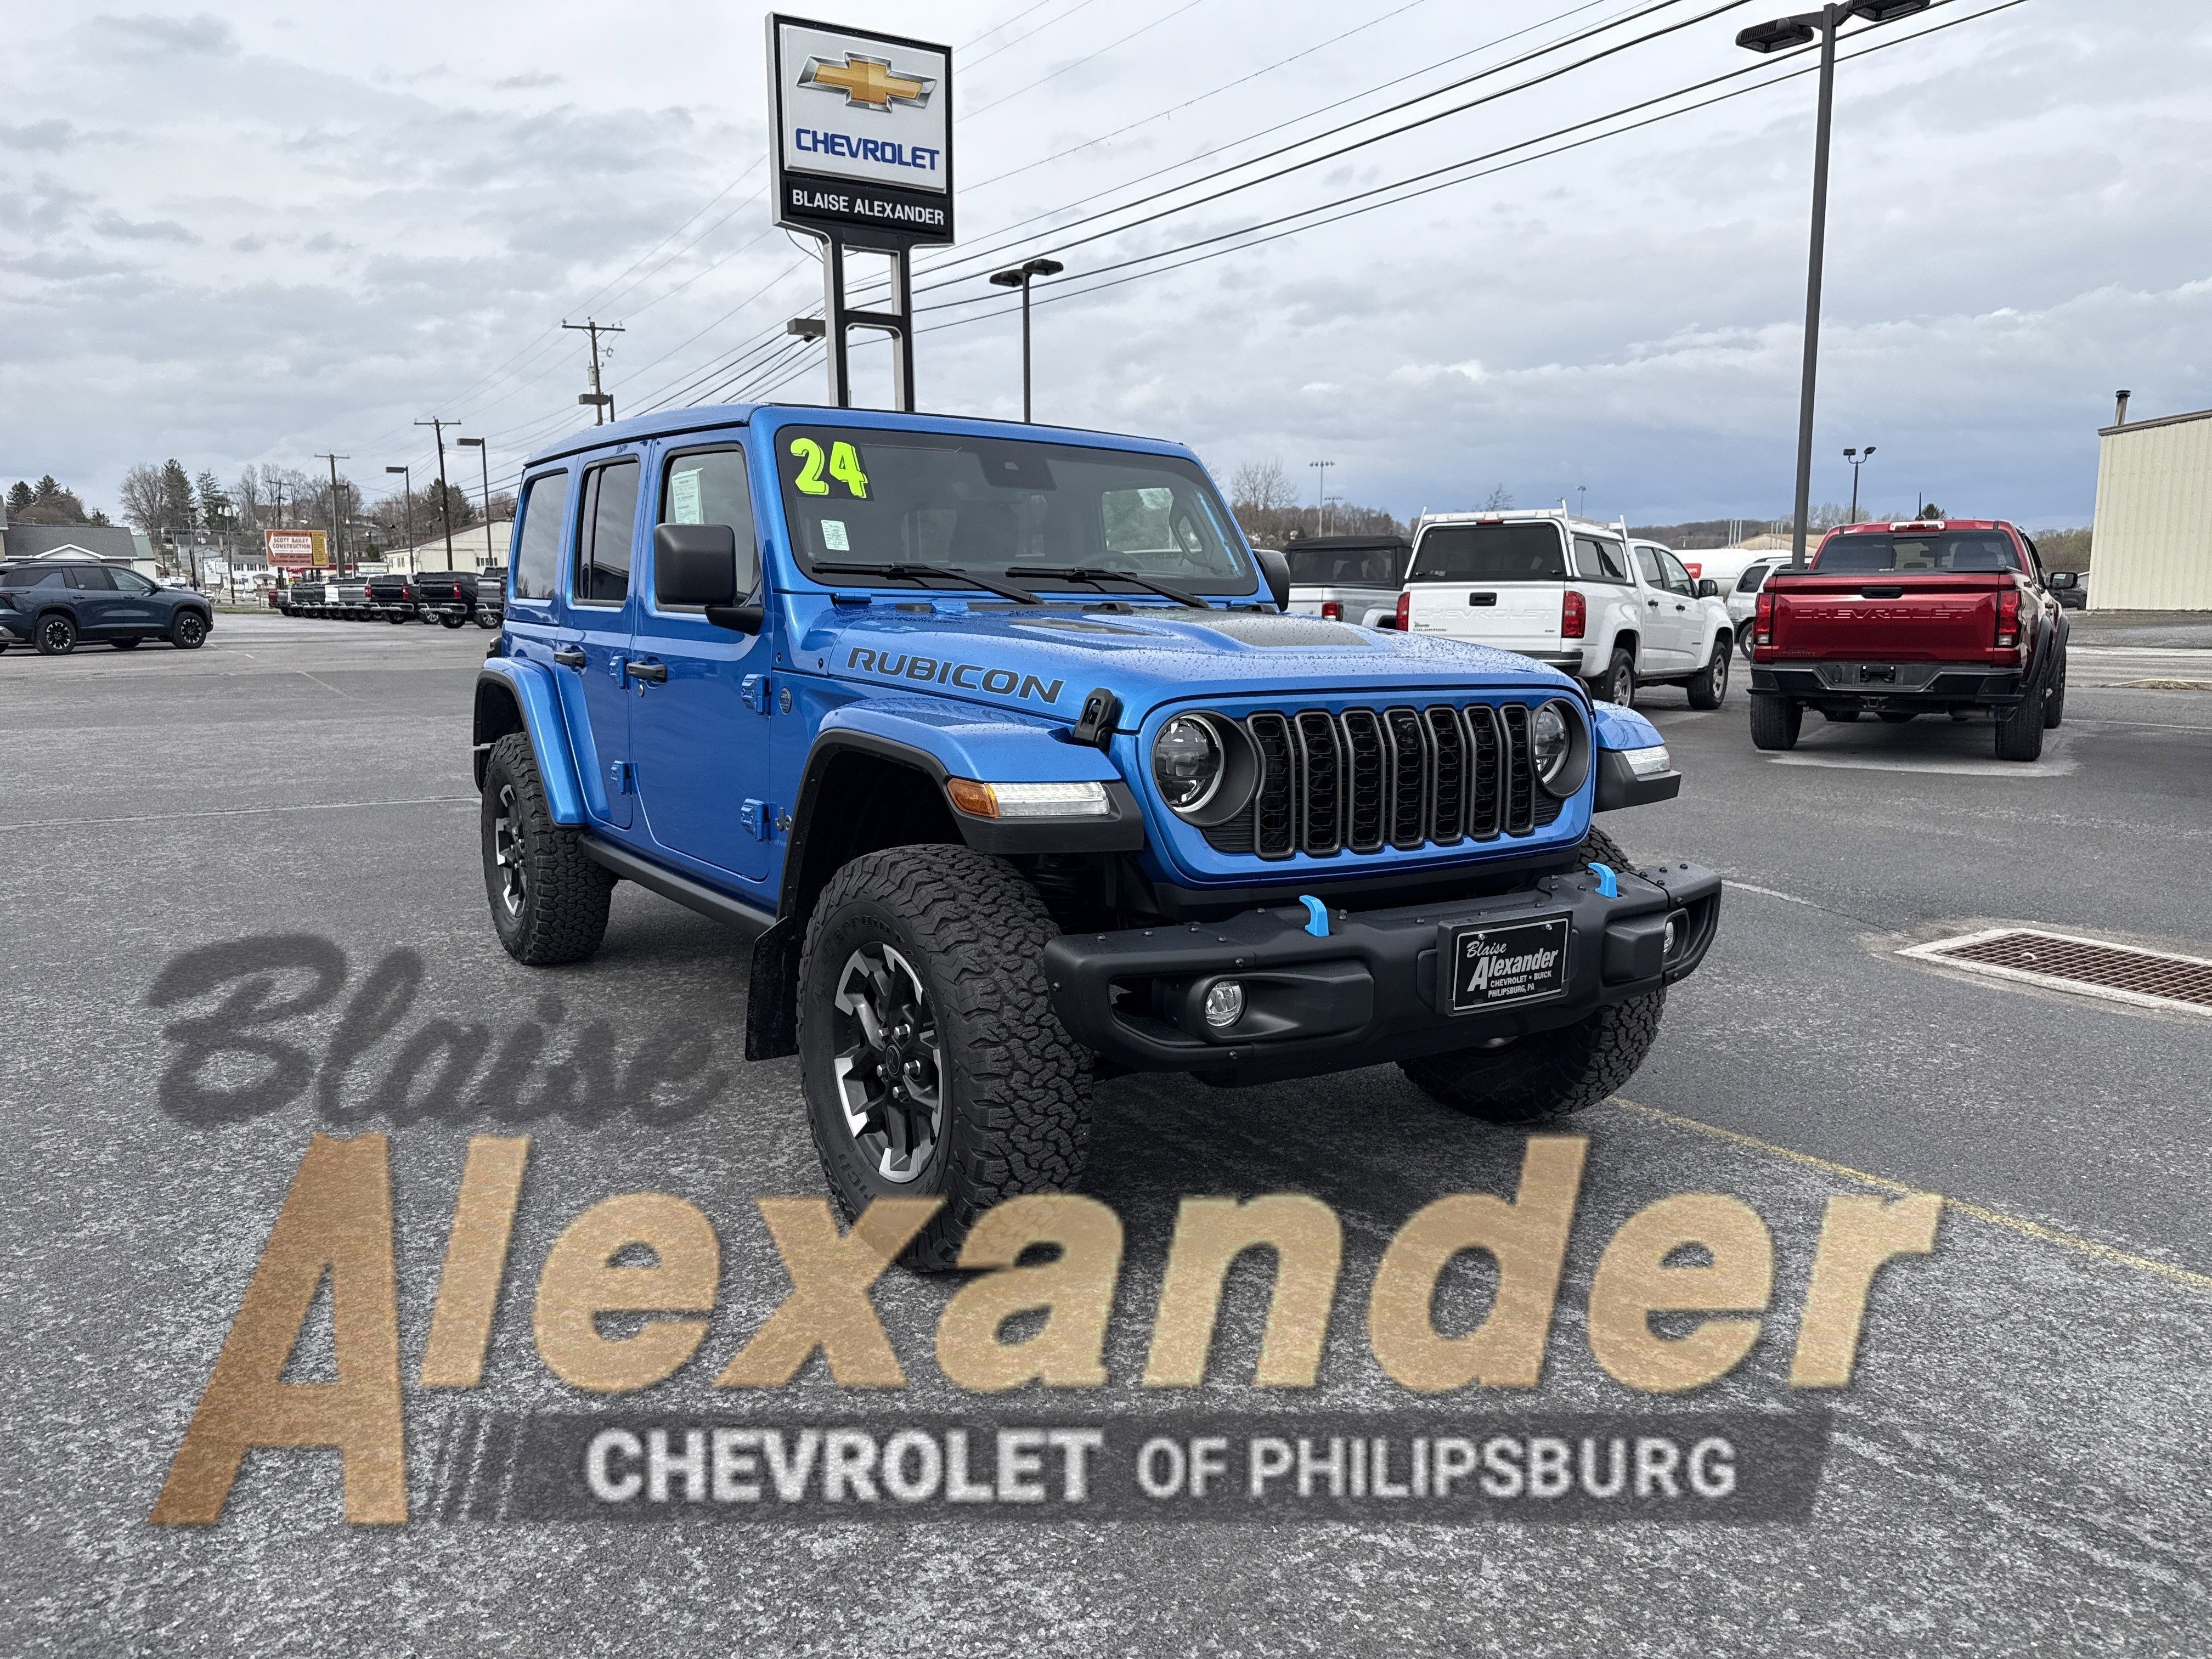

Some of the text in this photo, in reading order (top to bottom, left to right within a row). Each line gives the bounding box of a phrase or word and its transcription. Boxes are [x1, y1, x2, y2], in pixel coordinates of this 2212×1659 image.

[795, 128, 940, 170] CHEVROLET
[793, 189, 944, 225] BLAISE ALEXANDER
[790, 437, 868, 499] 24
[1415, 609, 1555, 619] CHEVROLET
[1795, 607, 1971, 620] CHEVROLET
[847, 646, 1066, 704] RUBICON
[1466, 941, 1507, 958] Blaise
[1467, 948, 1559, 992] Alexander
[1490, 970, 1552, 988] CHEVROLET BUICK
[1488, 983, 1535, 998] PHILIPSBURG, PA
